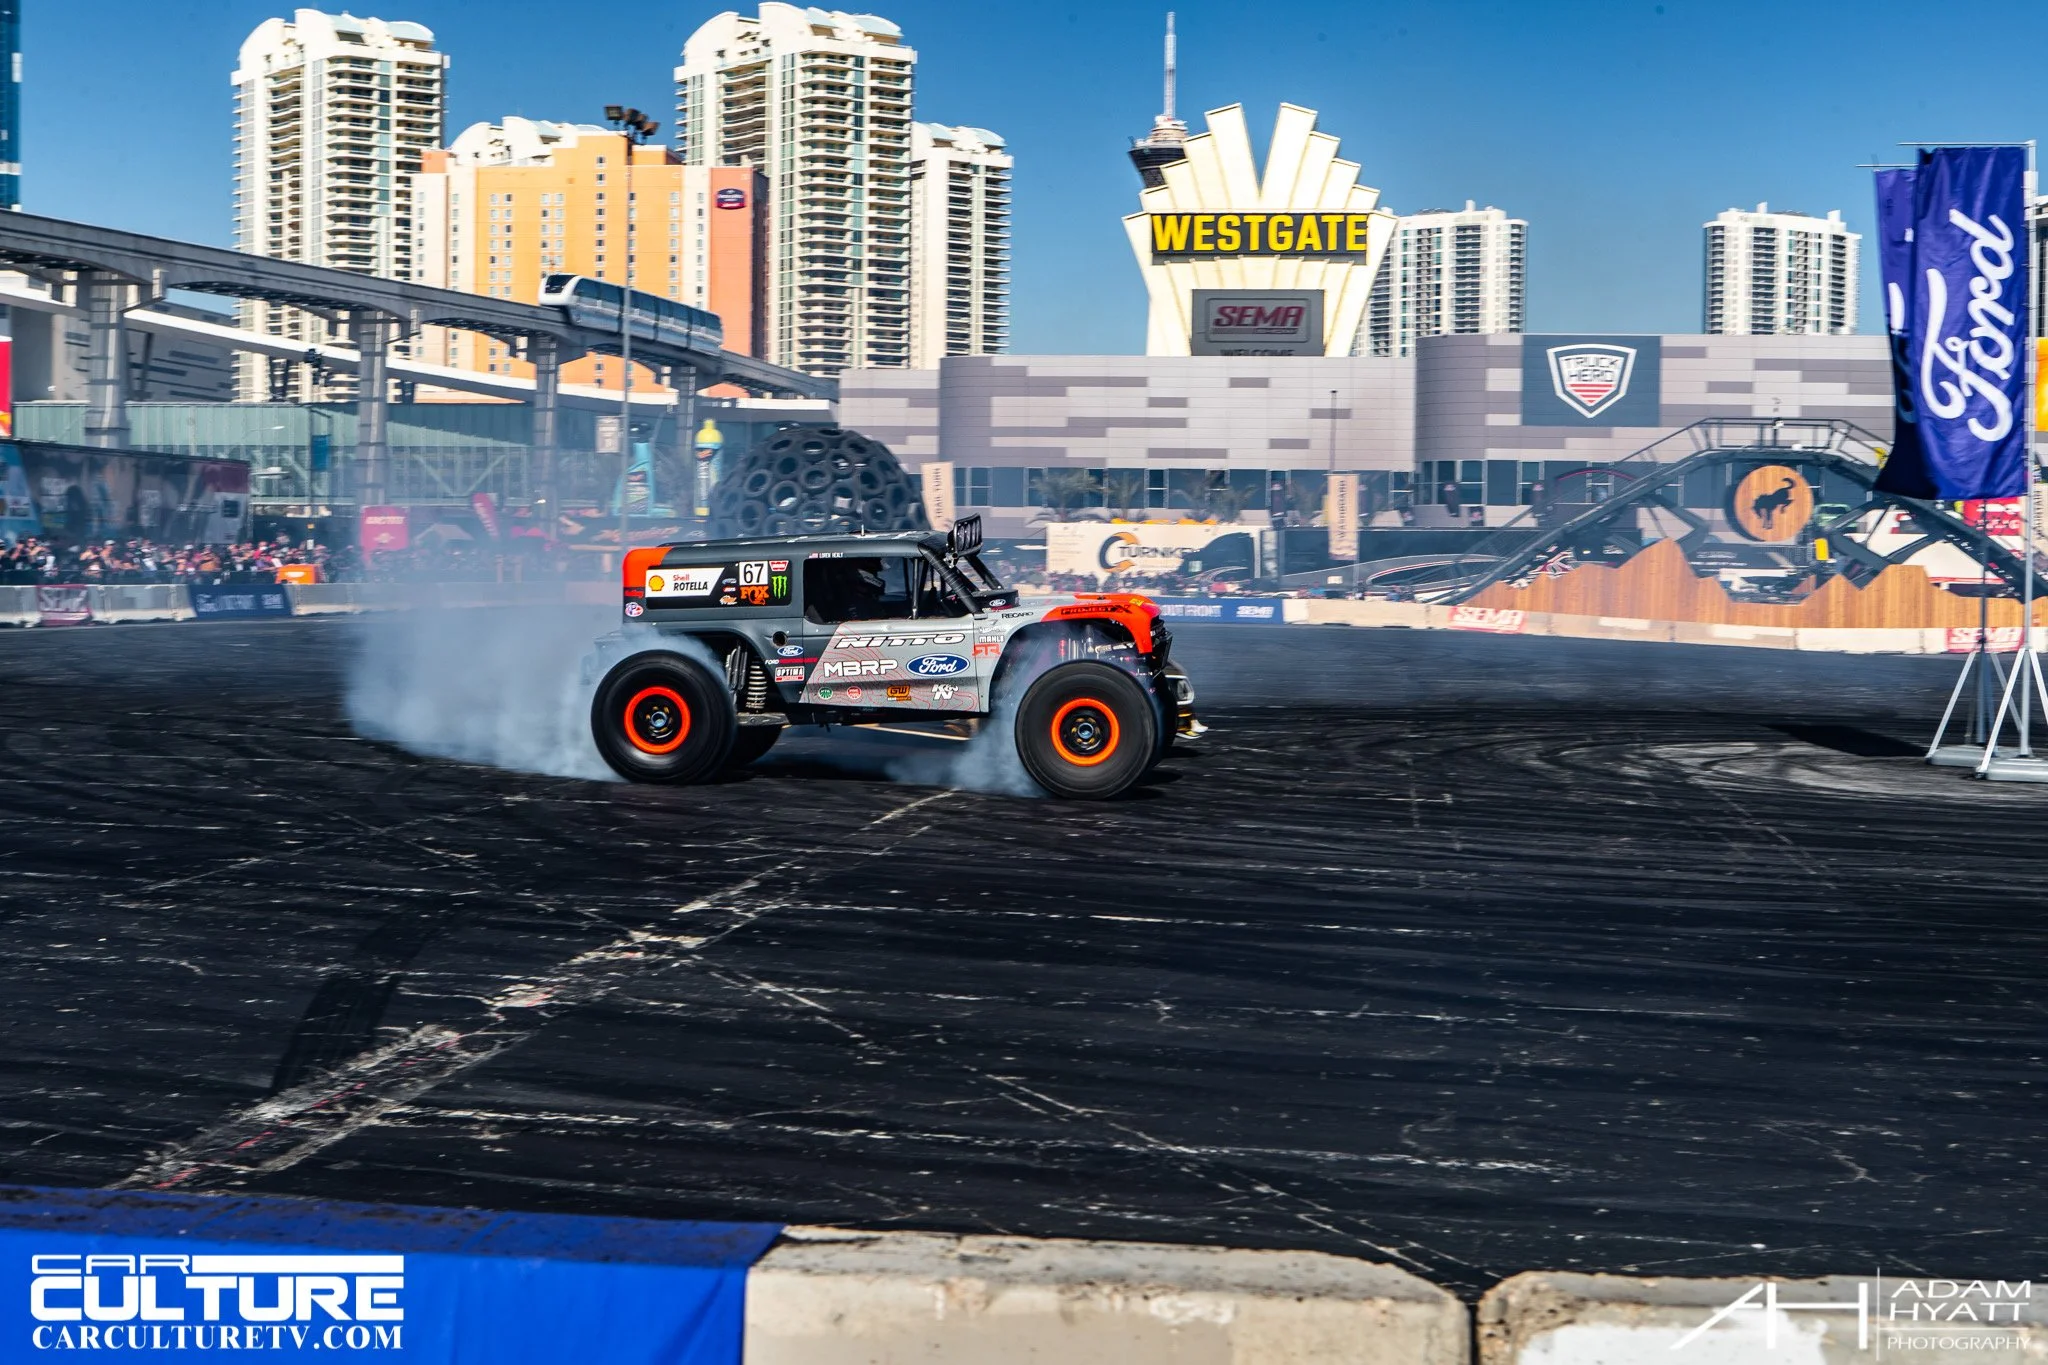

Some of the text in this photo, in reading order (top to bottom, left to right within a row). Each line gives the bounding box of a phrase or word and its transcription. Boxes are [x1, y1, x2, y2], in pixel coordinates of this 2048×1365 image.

[1151, 214, 1368, 252] WESTGATE
[1212, 305, 1304, 327] SEMA
[1921, 208, 2014, 441] Ford
[1563, 356, 1619, 368] TRUCK
[1568, 369, 1614, 382] HERO
[743, 563, 764, 584] 67
[673, 581, 708, 591] ROTELLA
[740, 585, 769, 605] FOX
[1453, 607, 1524, 625] SEMA
[834, 633, 965, 649] NITTO
[776, 668, 803, 677] OPTIMA
[823, 659, 898, 677] MBRP
[919, 657, 957, 674] Ford
